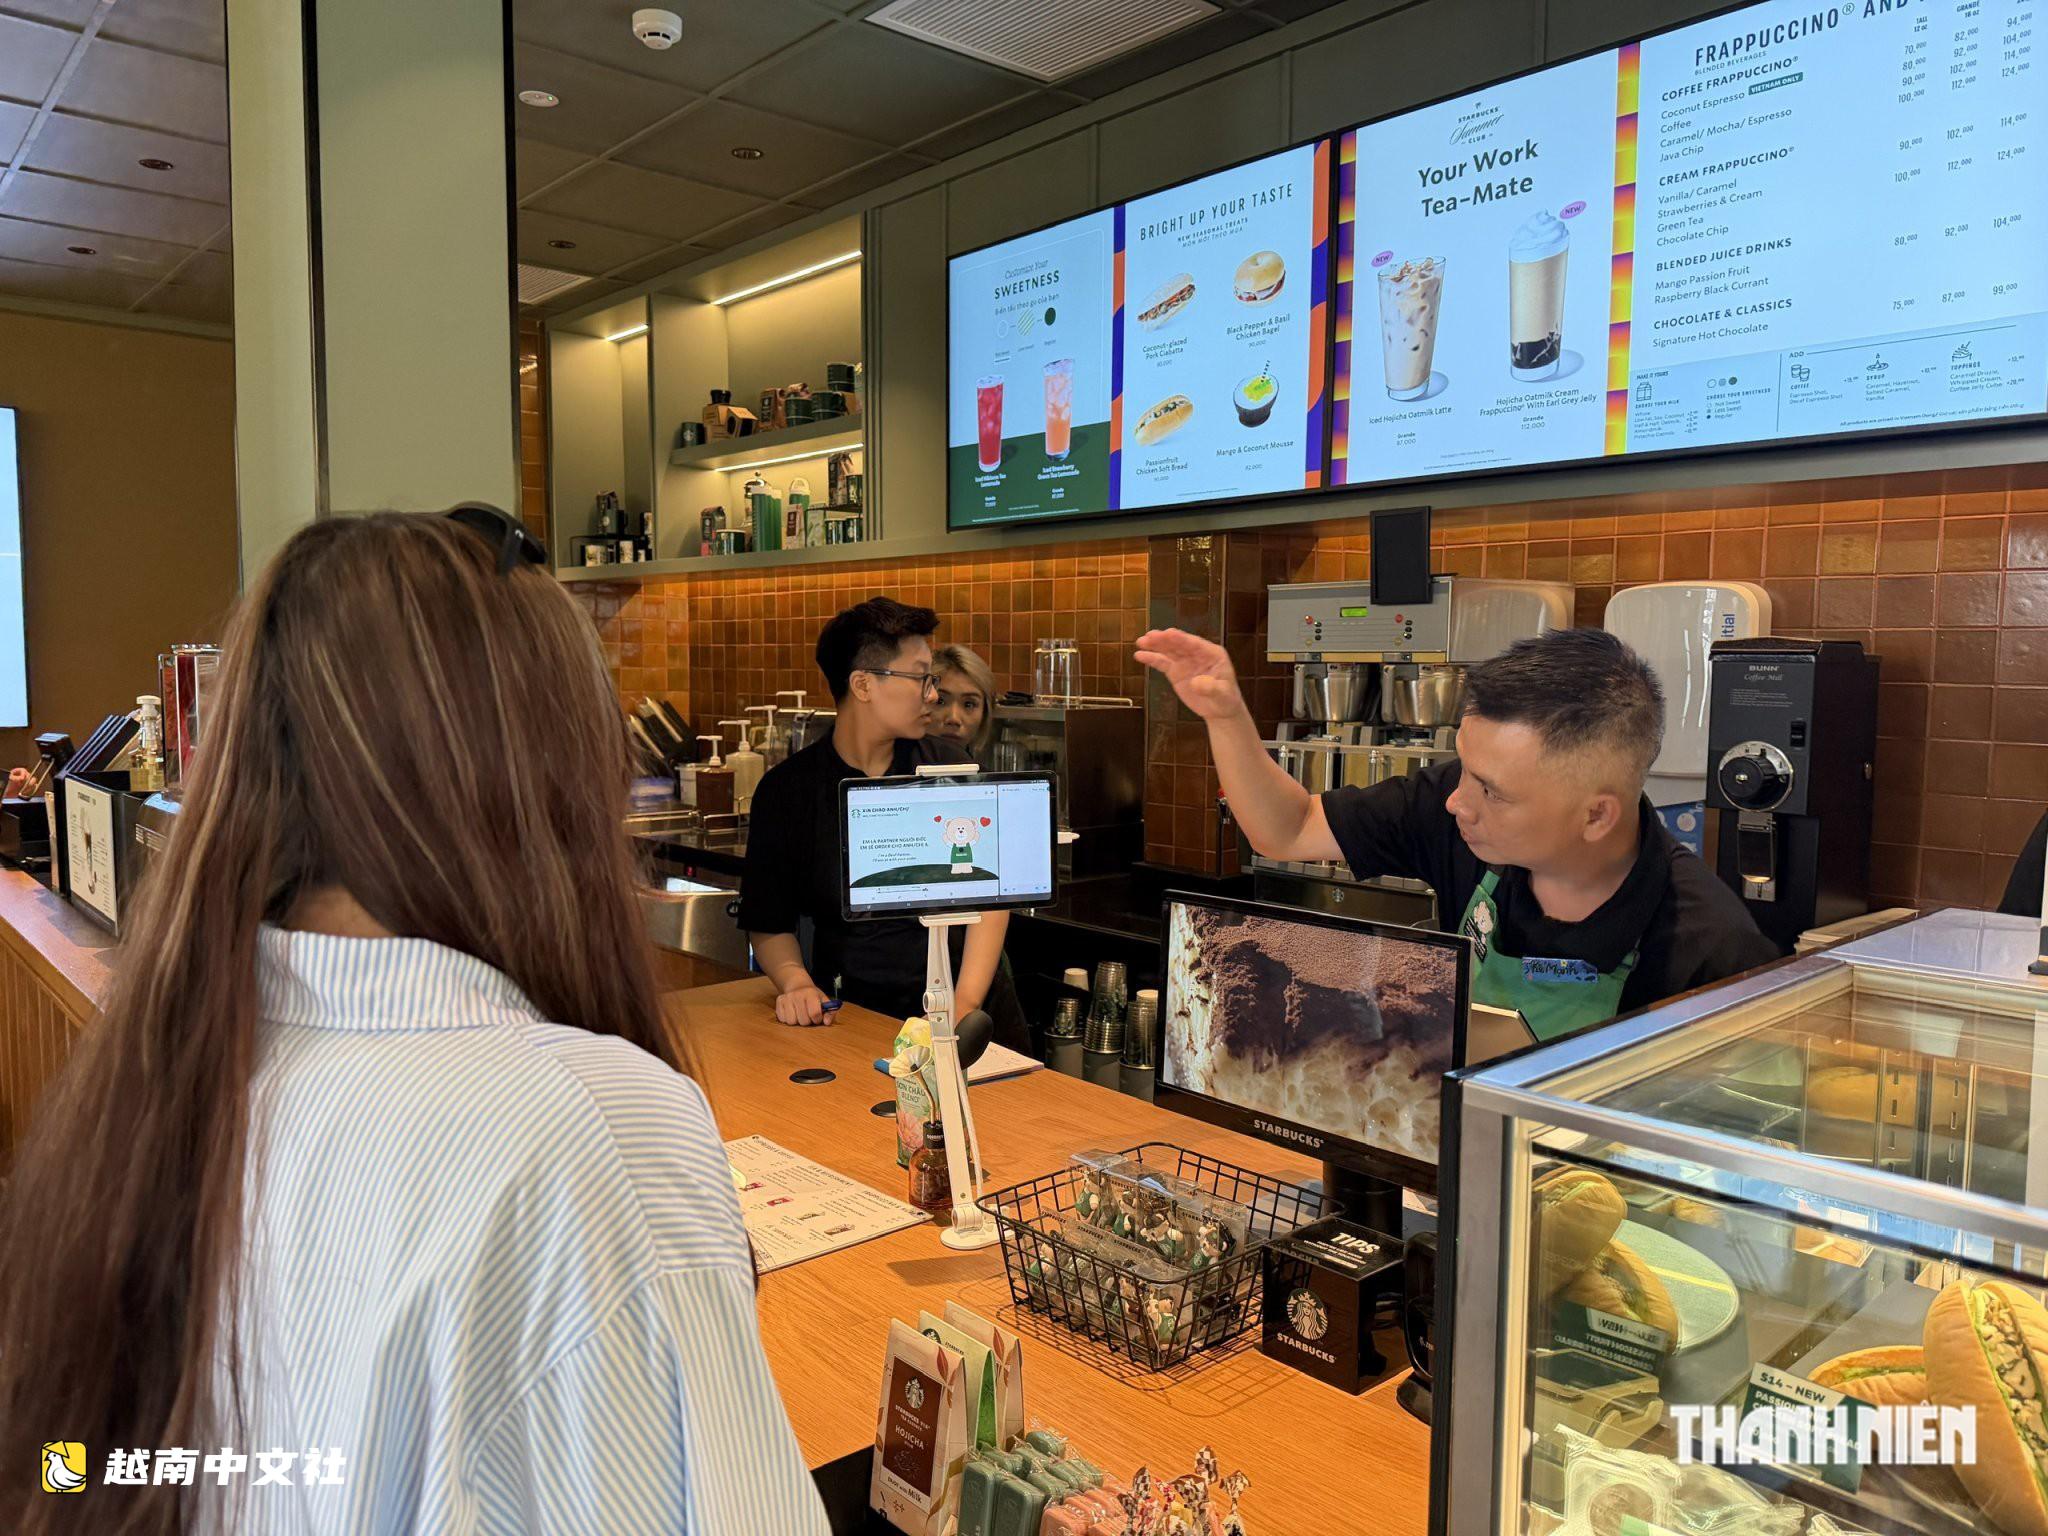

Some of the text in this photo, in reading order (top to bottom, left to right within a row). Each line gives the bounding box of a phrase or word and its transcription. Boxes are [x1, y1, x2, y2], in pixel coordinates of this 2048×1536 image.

[1695, 50, 1767, 76] BLENDED BEVERAGES
[1661, 74, 1800, 120] Coconut Espresso VIETNAM ONLY
[1662, 82, 1703, 102] COFFEE
[1458, 106, 1500, 123] STARBUCKS
[1660, 119, 1692, 134] Coffee
[1468, 134, 1486, 144] CLUB
[1660, 108, 1792, 148] Caramel/ Mocha/ Espresso
[1418, 138, 1539, 188] Your Work
[1660, 144, 1704, 162] Java Chip
[1659, 170, 1700, 186] CREAM
[1696, 178, 1738, 196] Caramel
[1140, 183, 1292, 240] BRIGHT UP YOUR TASTE
[1658, 190, 1763, 219] Strawberries & Cream
[1178, 217, 1248, 242] NEW SEASONAL TREATS
[1656, 225, 1729, 246] Chocolate Chip
[1657, 216, 1704, 232] Green Tea
[1656, 237, 1792, 272] BLENDED JUICE DRINKS
[994, 270, 1060, 300] SWEETNESS
[1656, 265, 1750, 290] Mango Passion Fruit
[1654, 276, 1769, 304] Raspberry Black Currant
[1654, 298, 1793, 330] CHOCOLATE & CLASSICS
[1652, 324, 1769, 348] Signature Hot Chocolate
[1496, 396, 1523, 406] Hojicha
[1554, 388, 1579, 397] Cream
[1527, 400, 1545, 410] With
[1561, 397, 1579, 407] Grey
[1580, 394, 1597, 404] Jelly
[1383, 413, 1407, 424] Hojicha
[1435, 406, 1452, 416] Latte
[1254, 1120, 1322, 1148] STARBUCKS
[1330, 1232, 1380, 1254] TIPS
[1276, 1332, 1336, 1364] STARBUCKS
[1796, 1385, 1826, 1403] NEW
[896, 1424, 924, 1450] HOJICHA
[908, 1488, 922, 1504] Milk
